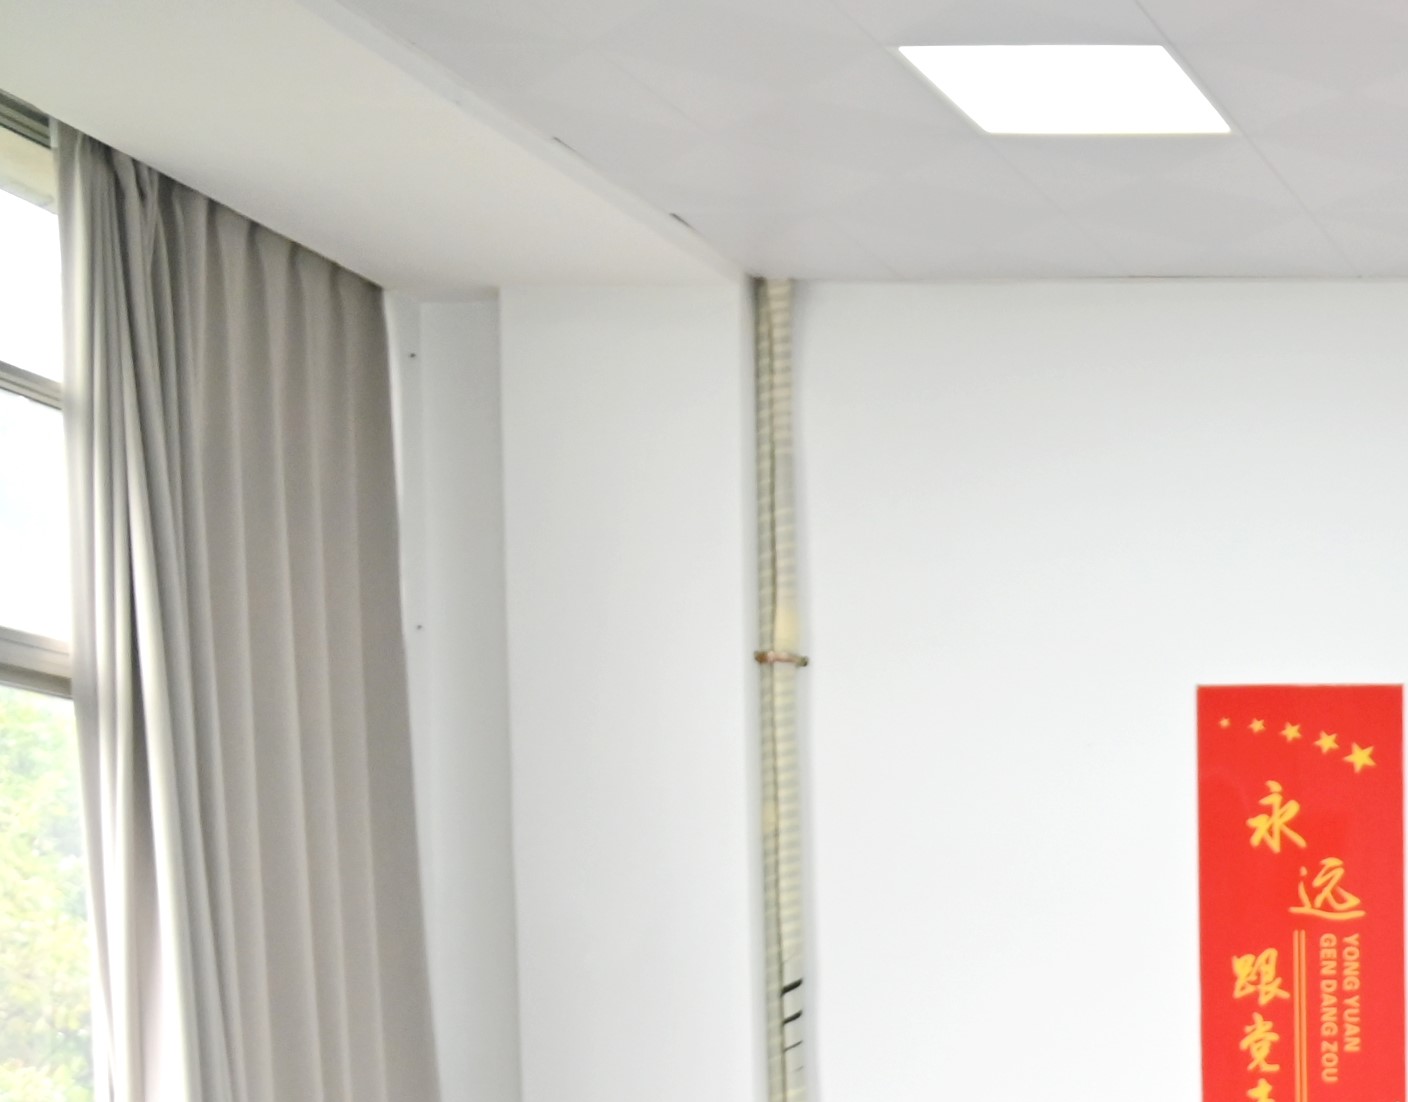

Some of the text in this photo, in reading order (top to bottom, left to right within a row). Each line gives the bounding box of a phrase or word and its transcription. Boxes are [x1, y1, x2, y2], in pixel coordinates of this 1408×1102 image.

[1319, 933, 1338, 1083] GEN DANG ZOU
[1342, 933, 1360, 1053] YONG YUAN
